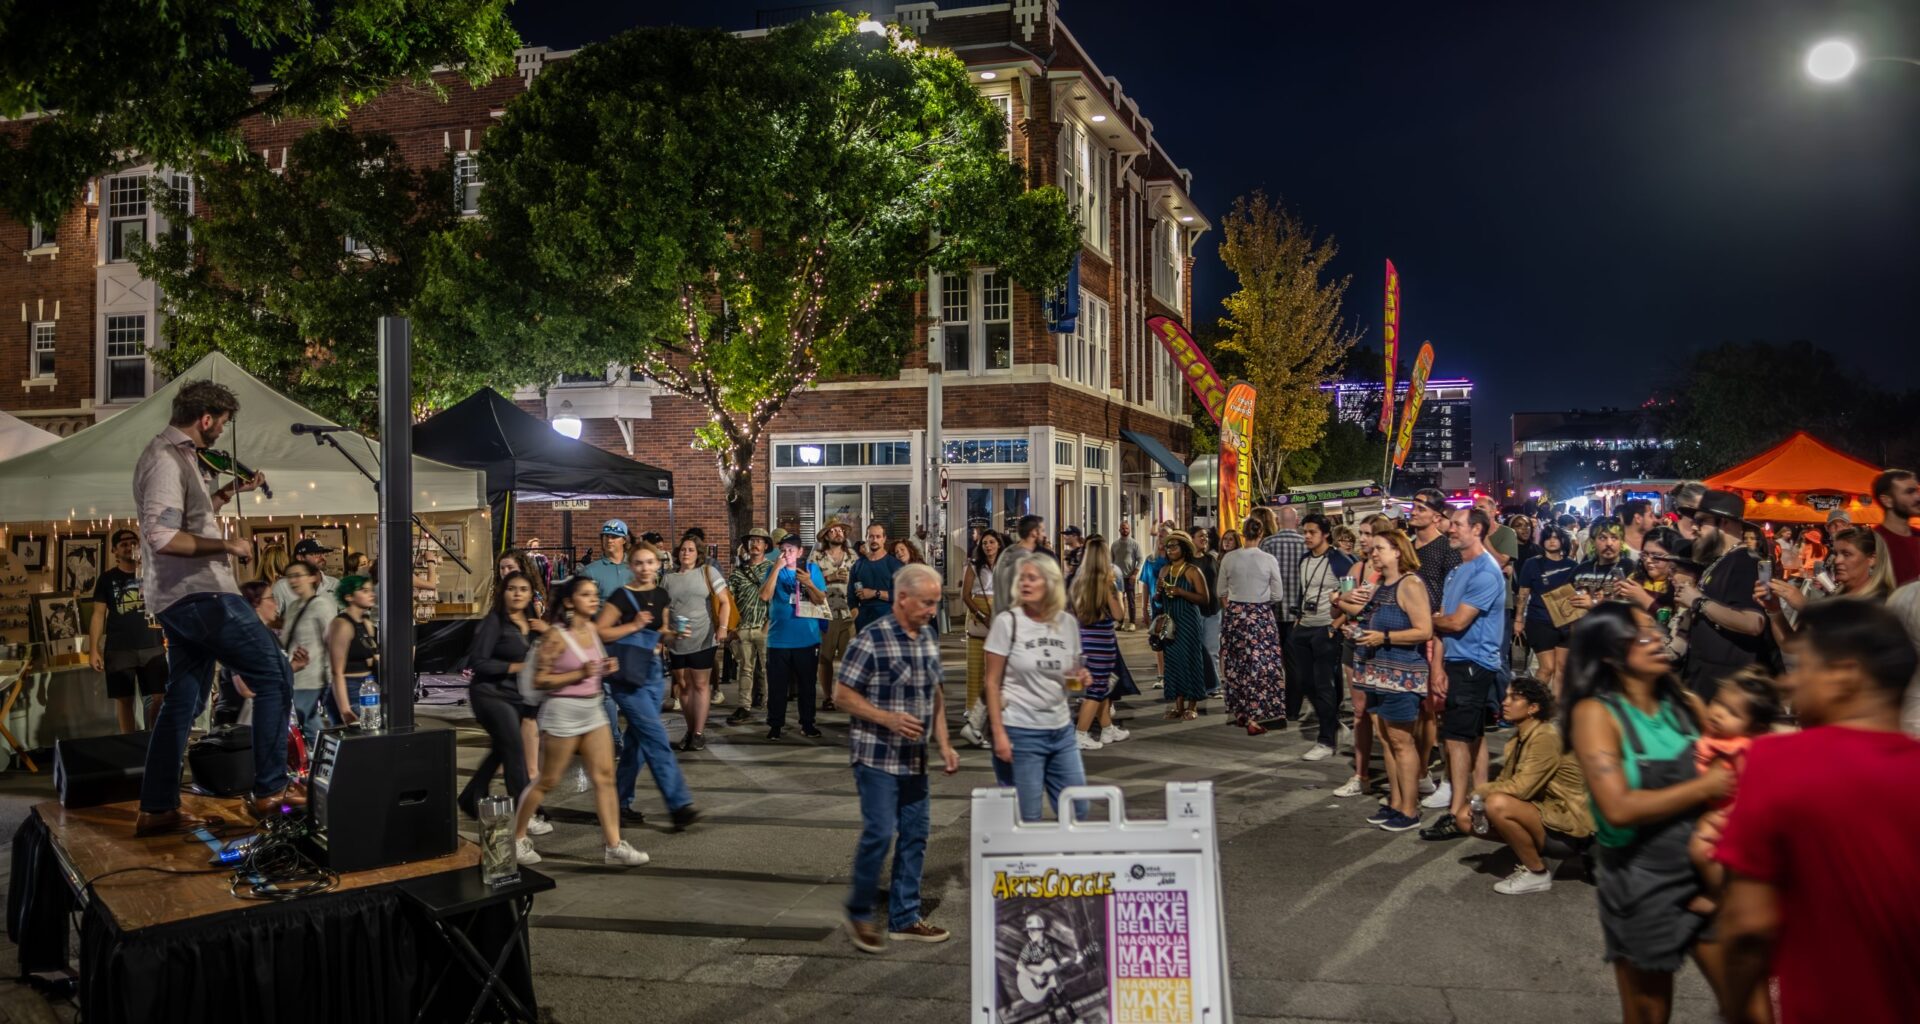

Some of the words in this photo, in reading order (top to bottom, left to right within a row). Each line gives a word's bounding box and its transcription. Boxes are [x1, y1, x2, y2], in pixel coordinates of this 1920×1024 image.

[572, 499, 588, 507] LANE
[1117, 891, 1185, 903] MAGNOLIA
[1117, 902, 1187, 921] MAKE
[1117, 920, 1188, 934] BELIEVE
[1118, 934, 1186, 946] MAGNOLIA
[1118, 945, 1188, 964] MAKE
[1118, 964, 1189, 978] BELIEVE
[1120, 979, 1188, 990] MAGNOLIA
[1120, 990, 1189, 1009] MAKE
[1120, 1008, 1190, 1022] BELIEVE
